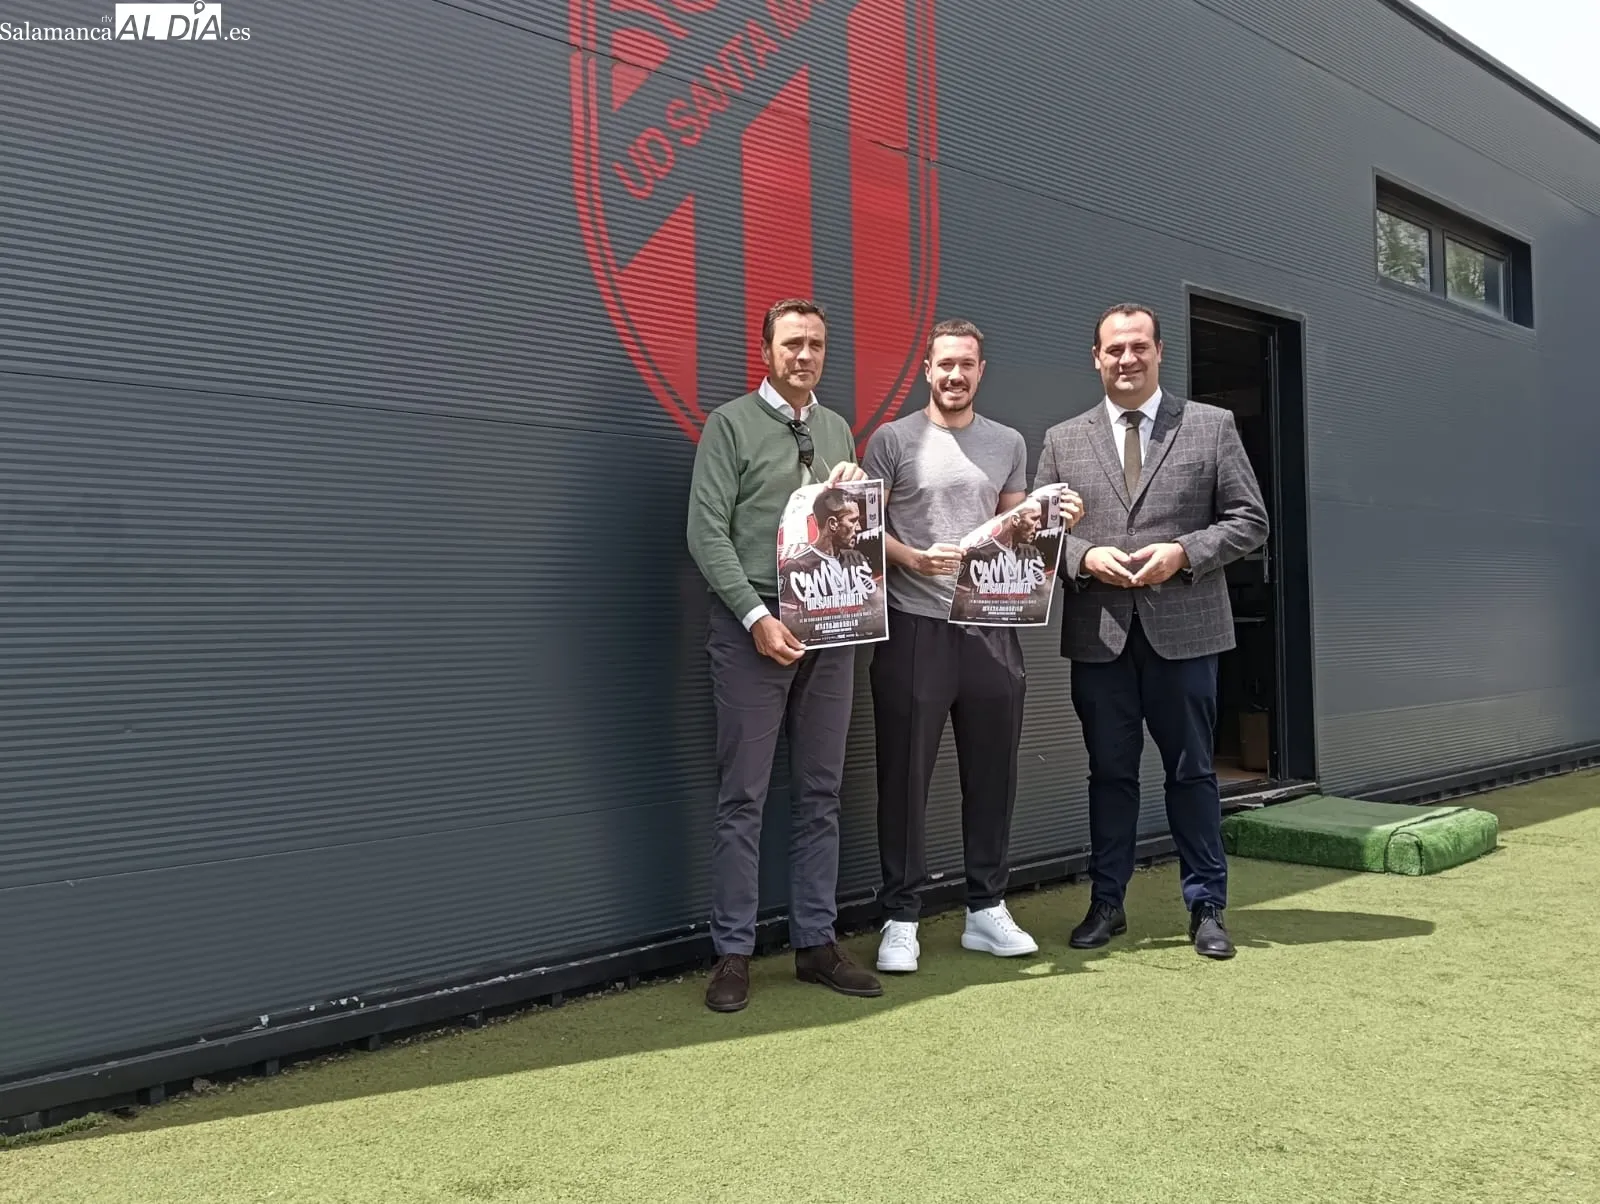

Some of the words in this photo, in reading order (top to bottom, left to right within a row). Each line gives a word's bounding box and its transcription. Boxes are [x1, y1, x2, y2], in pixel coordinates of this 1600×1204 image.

[612, 127, 676, 200] UD
[666, 18, 780, 147] SANTA
[789, 559, 877, 600] CAMPUS
[970, 551, 1047, 590] CAMPUS
